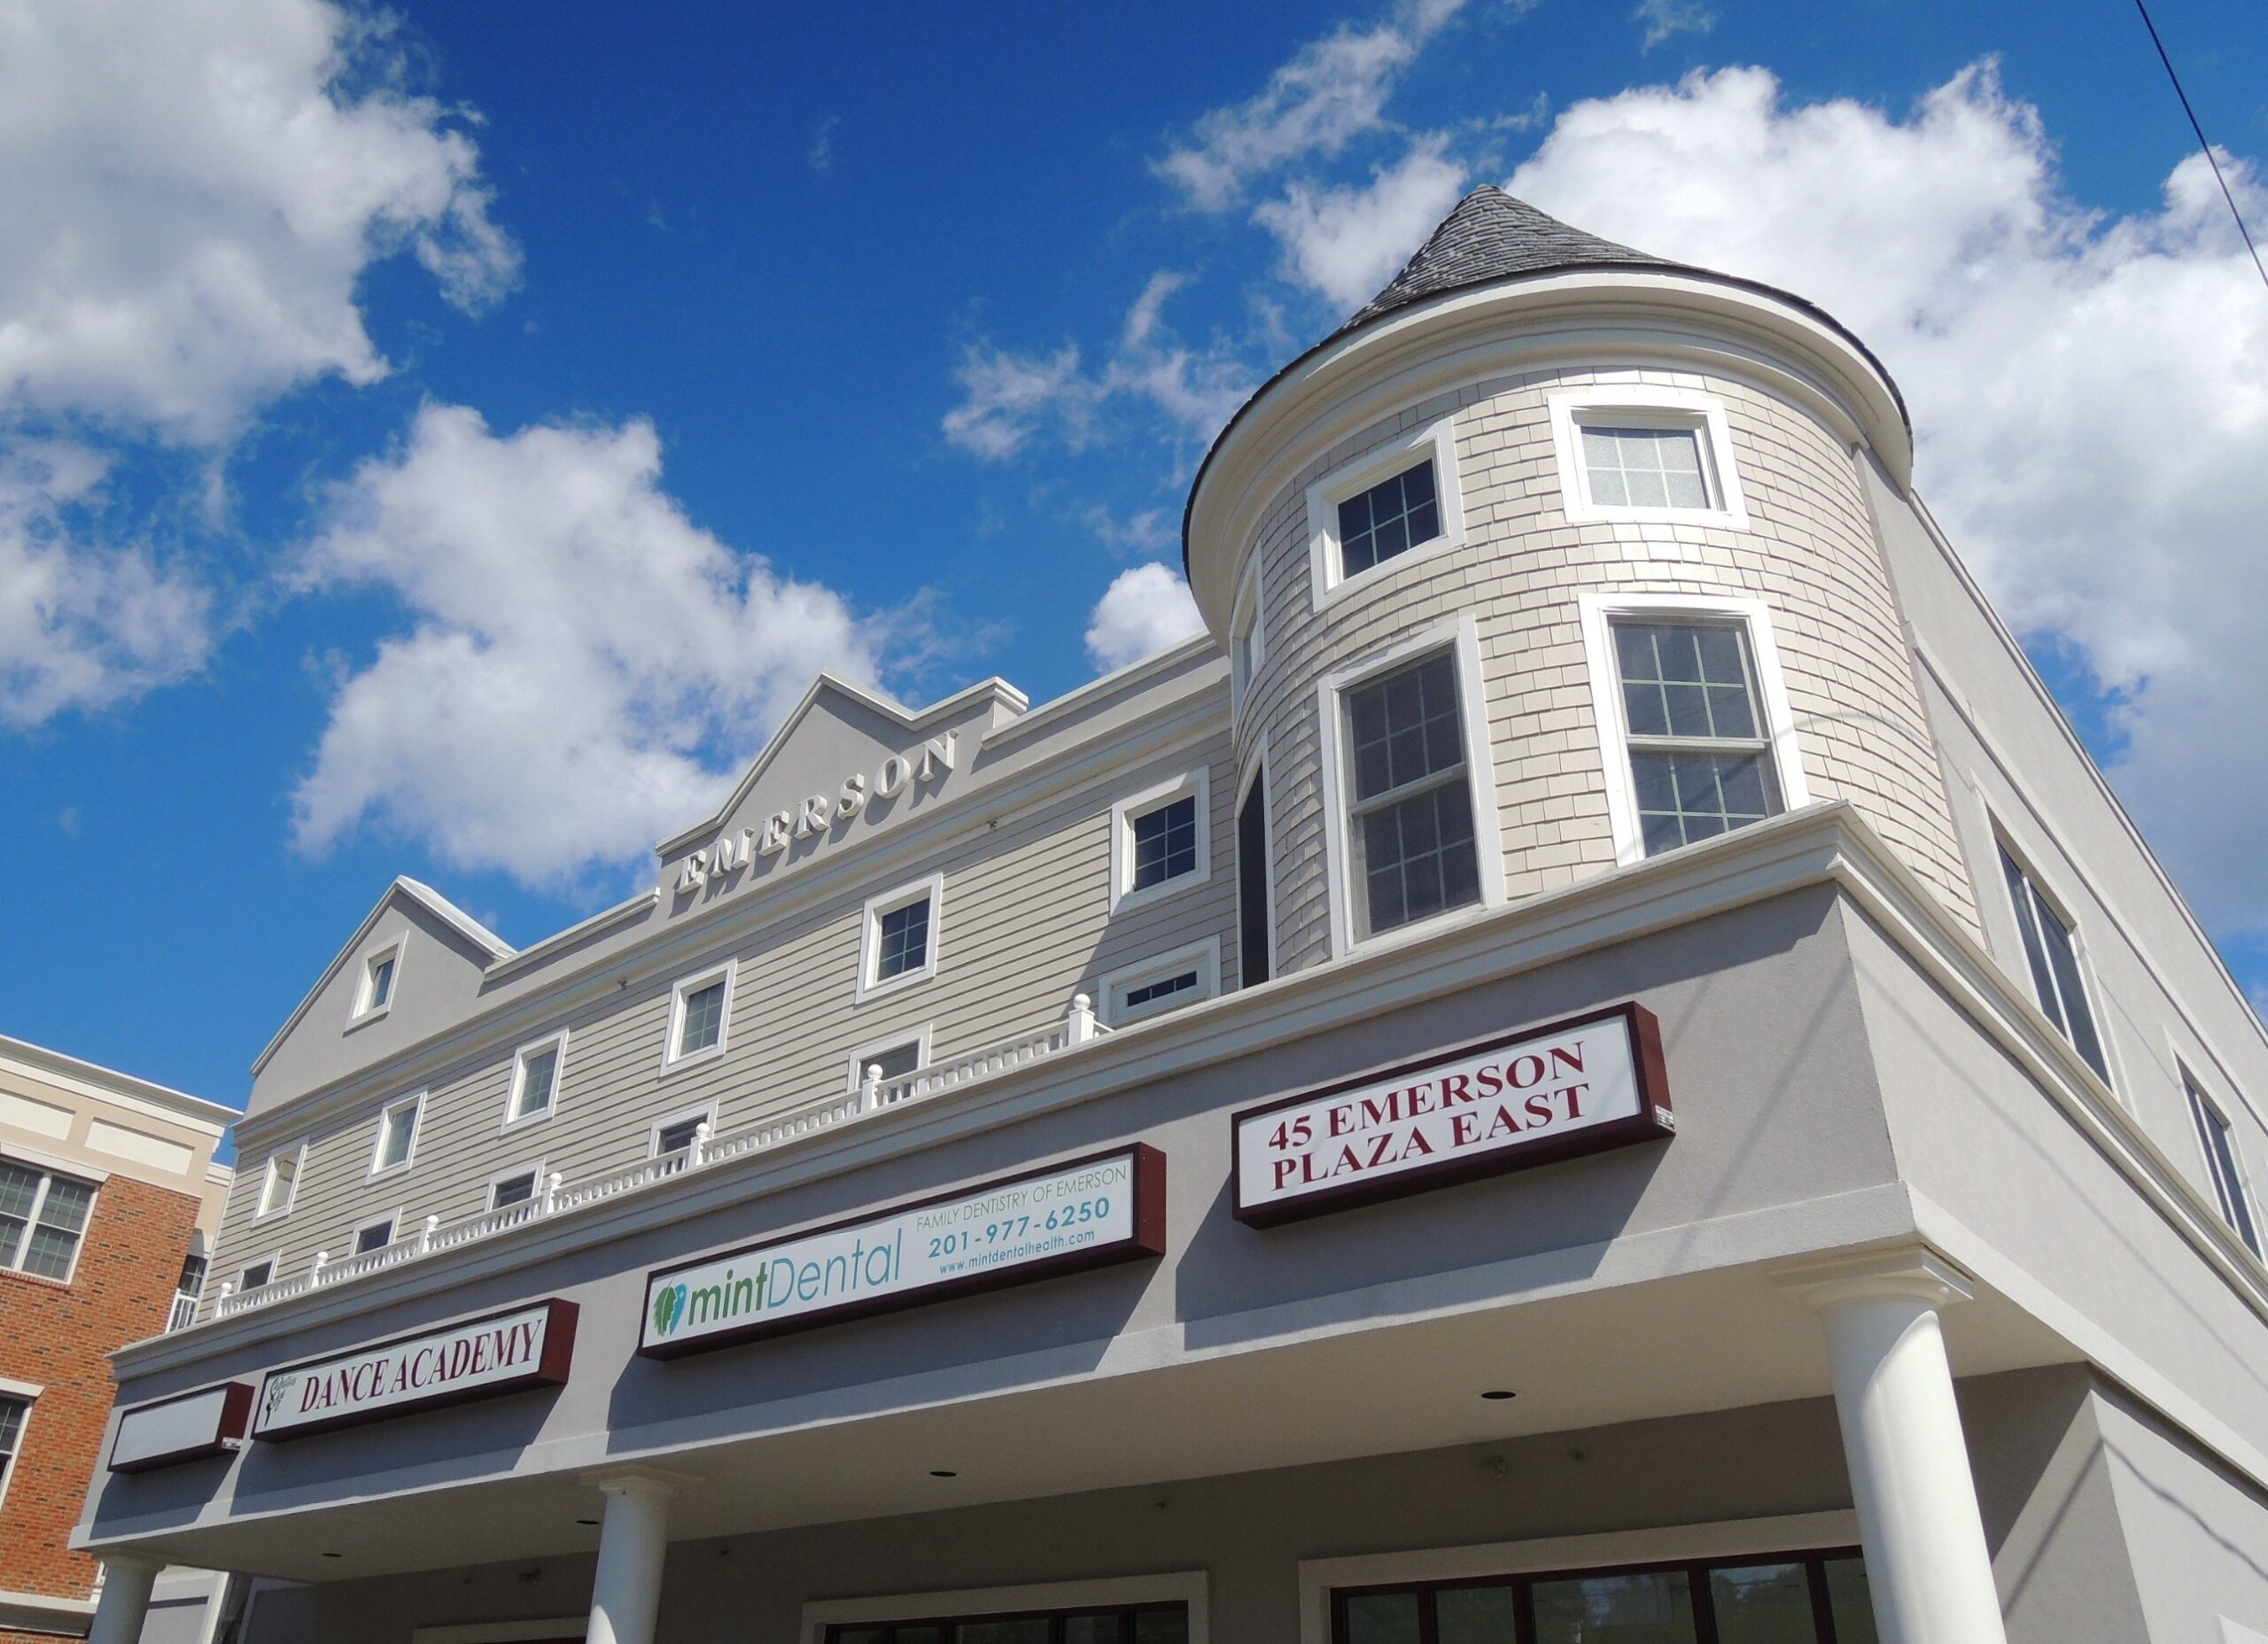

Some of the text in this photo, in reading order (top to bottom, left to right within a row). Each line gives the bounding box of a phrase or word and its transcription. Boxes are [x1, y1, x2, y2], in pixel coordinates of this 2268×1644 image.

[675, 729, 959, 895] EMERSON
[1269, 1042, 1585, 1151] 45 EMERSON
[1270, 1083, 1589, 1191] PLAZA EAST
[916, 1166, 1127, 1232] FAMILY DENTISTRY OF EMERSON
[928, 1198, 1110, 1258] 201-977-6250
[939, 1229, 1095, 1275] www.mintdentalhealth.com
[299, 1319, 542, 1413] DANCE ACADEMY
